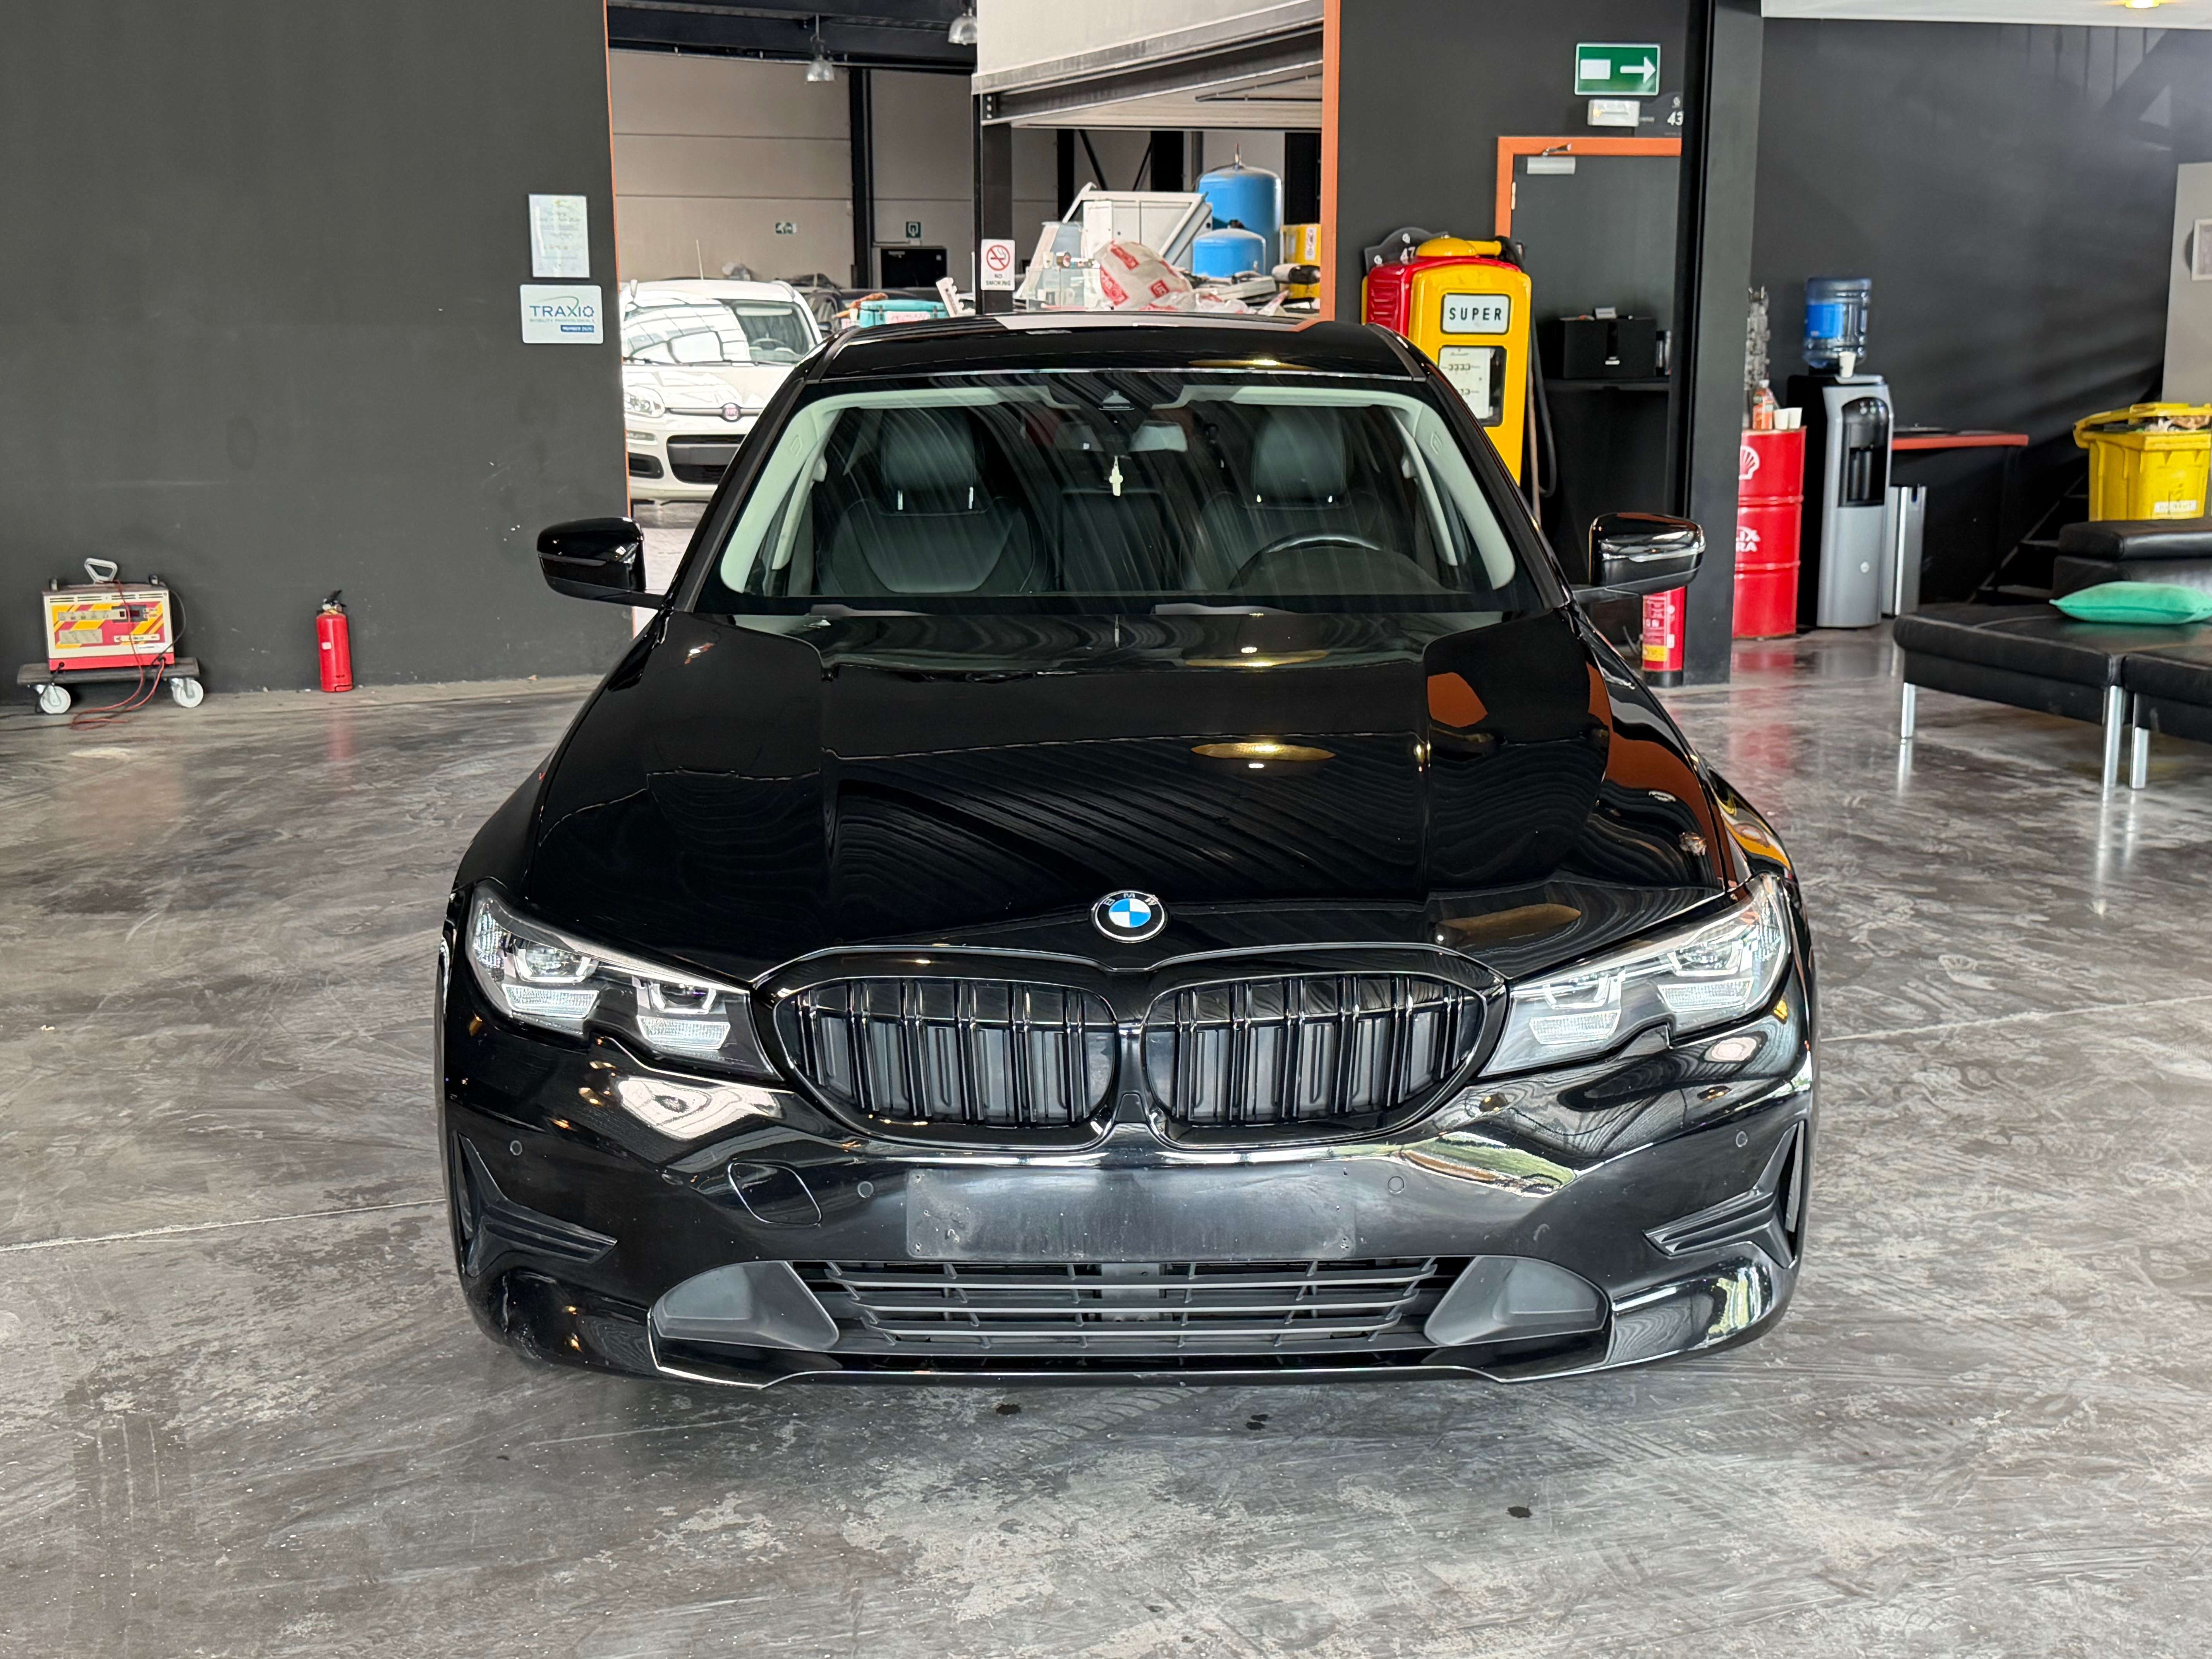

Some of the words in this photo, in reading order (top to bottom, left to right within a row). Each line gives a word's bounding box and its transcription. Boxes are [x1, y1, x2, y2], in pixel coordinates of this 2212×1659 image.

[1667, 111, 1684, 126] 43
[529, 305, 595, 318] TRAXIO
[1449, 307, 1502, 321] SUPER
[1103, 893, 1159, 907] BMW
